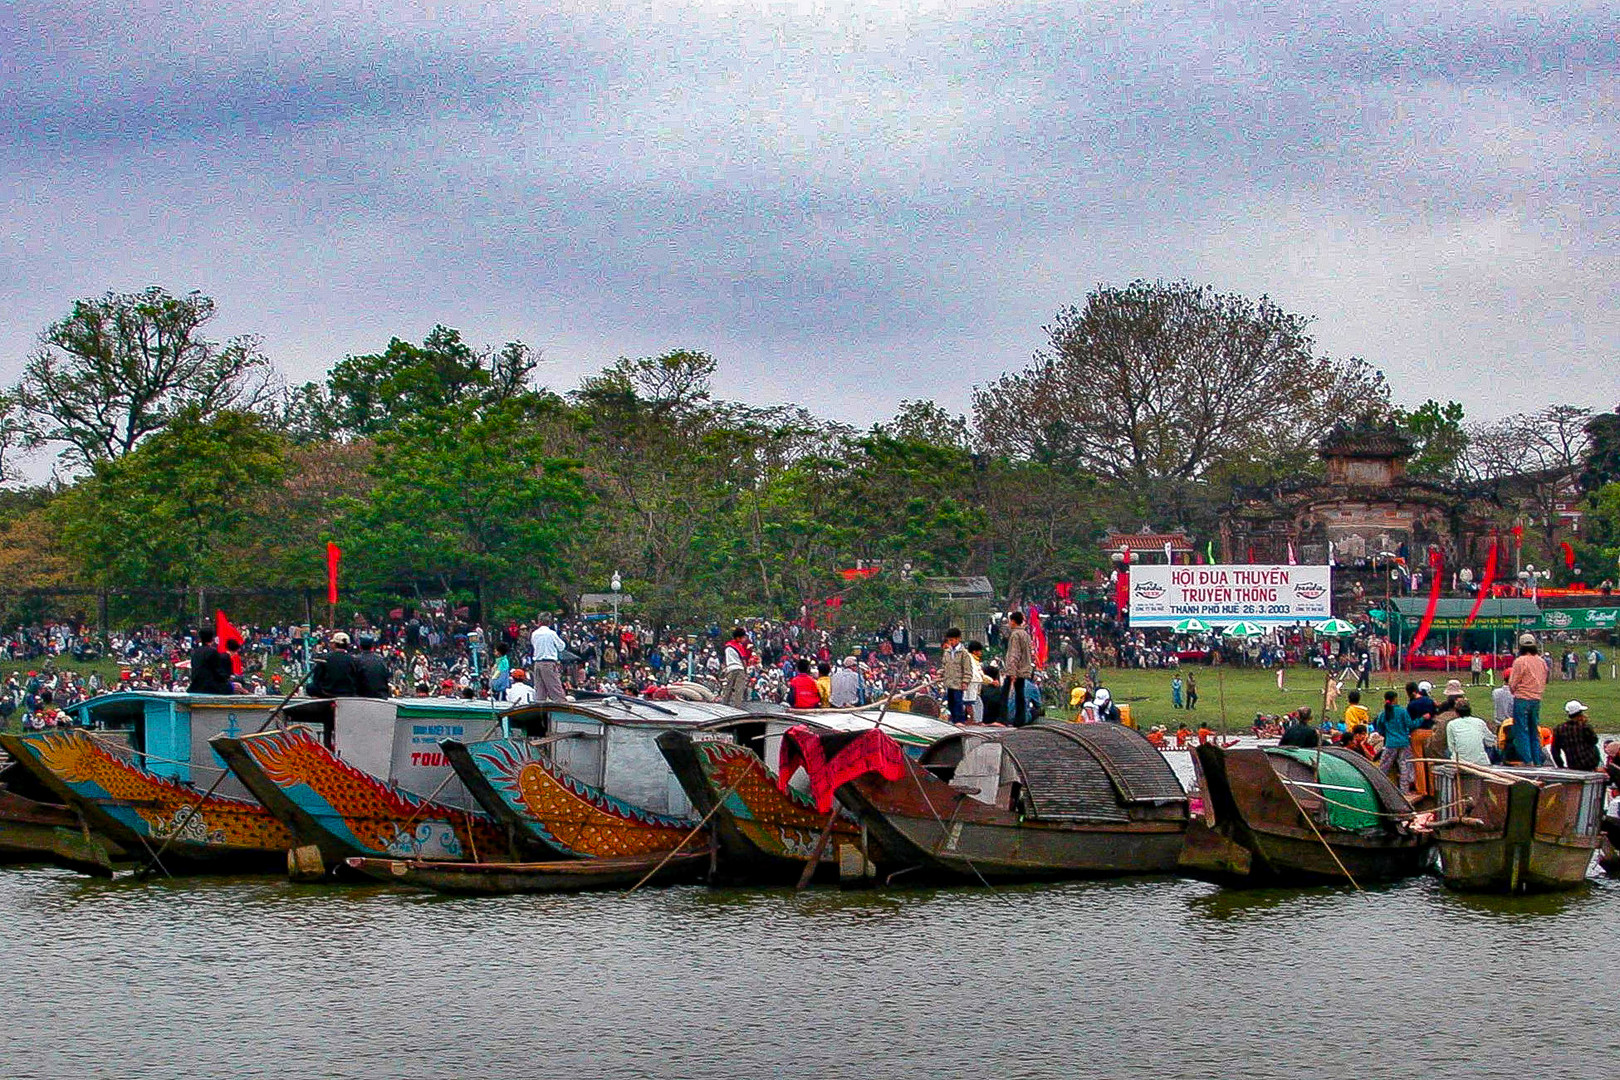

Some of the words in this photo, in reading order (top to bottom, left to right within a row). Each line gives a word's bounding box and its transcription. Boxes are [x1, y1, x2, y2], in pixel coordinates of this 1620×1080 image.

[1172, 568, 1194, 587] HỘI
[1199, 571, 1228, 584] ĐUA
[1233, 566, 1289, 584] THUYỀN
[1182, 585, 1231, 602] TRUYỀN
[1235, 585, 1277, 602] THỐNG
[1170, 602, 1199, 613] THÀNH
[1202, 602, 1220, 613] PHỐ
[1222, 602, 1239, 613] HUẾ
